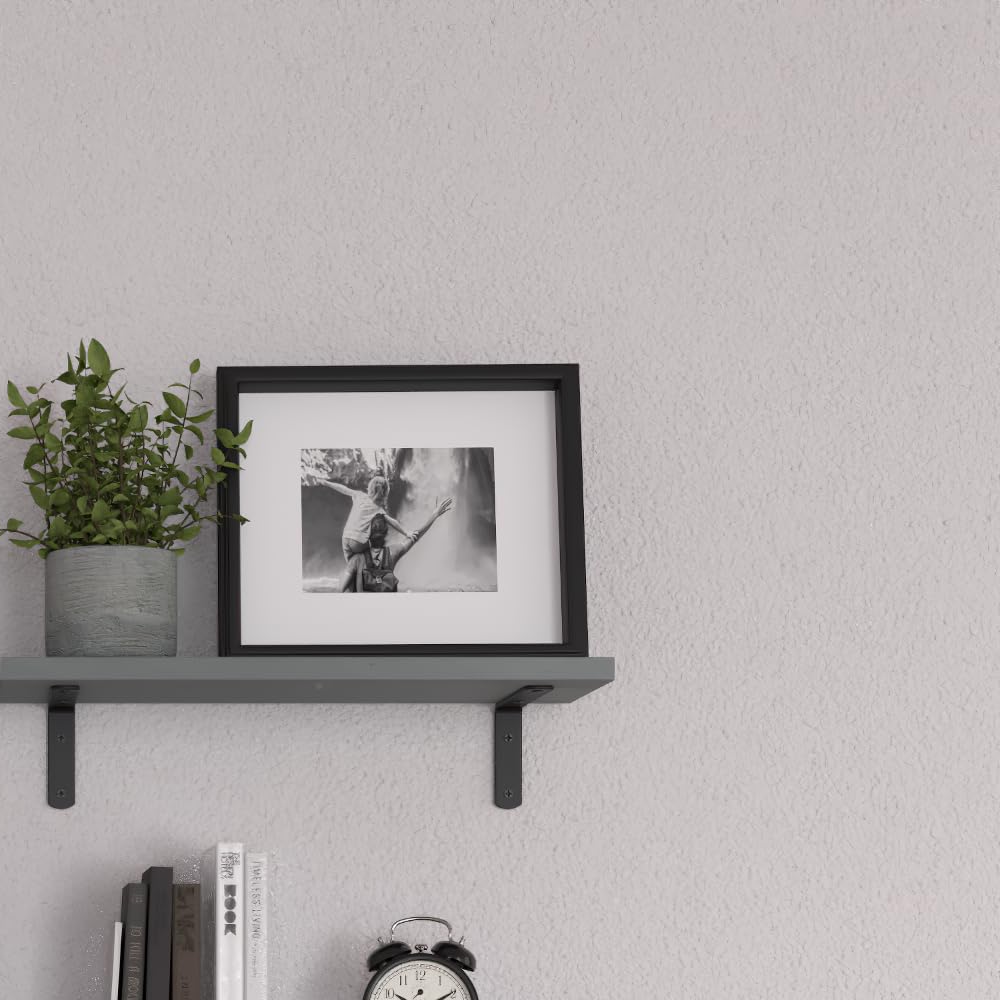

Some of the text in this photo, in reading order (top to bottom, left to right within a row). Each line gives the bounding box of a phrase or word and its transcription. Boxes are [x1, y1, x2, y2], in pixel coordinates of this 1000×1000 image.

[399, 975, 408, 986] 11
[415, 970, 426, 981] 12
[438, 975, 442, 986] 1
[385, 989, 395, 999] 10
